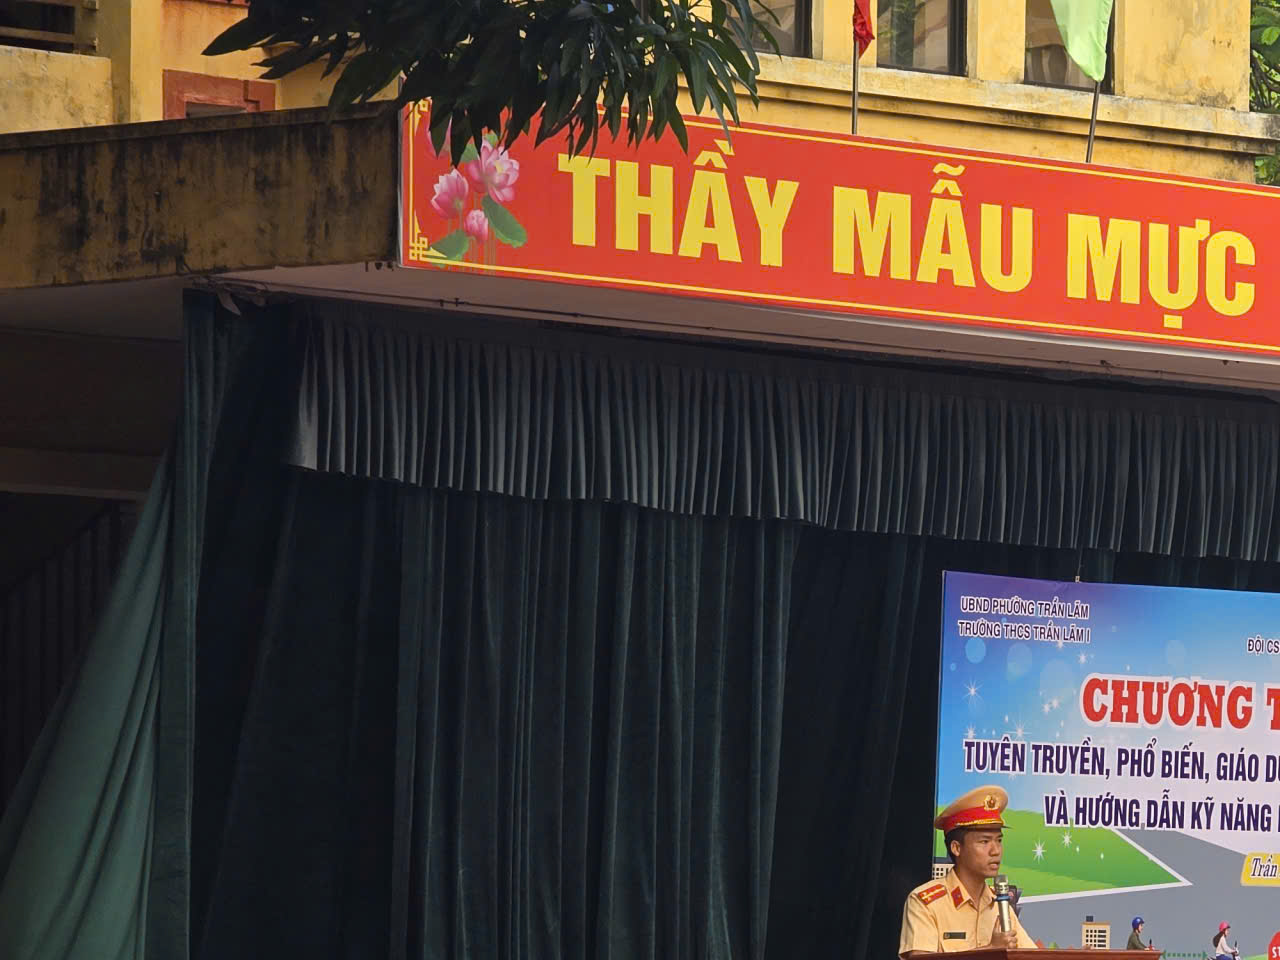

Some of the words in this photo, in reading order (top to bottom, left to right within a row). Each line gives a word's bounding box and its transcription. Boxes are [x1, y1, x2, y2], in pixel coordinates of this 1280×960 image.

[558, 138, 799, 267] THẦY
[832, 163, 1034, 293] MẪU
[1066, 214, 1256, 330] MỰC
[961, 597, 989, 613] UBND
[1004, 624, 1031, 640] THCS
[1247, 638, 1265, 656] ĐỘI
[1082, 677, 1253, 730] CHƯƠNG
[965, 736, 1026, 773] TUYÊN
[1032, 737, 1111, 779] TRUYỀN,
[1117, 737, 1157, 778] PHỔ
[1161, 742, 1210, 784] BIẾN,
[1216, 748, 1259, 783] GIÁO
[1044, 790, 1069, 825] VÀ
[1075, 792, 1140, 828] HƯỚNG
[1146, 788, 1185, 829] DẪN
[1191, 797, 1215, 830] KỸ
[1220, 797, 1272, 833] NĂNG
[1251, 855, 1278, 878] Trần
